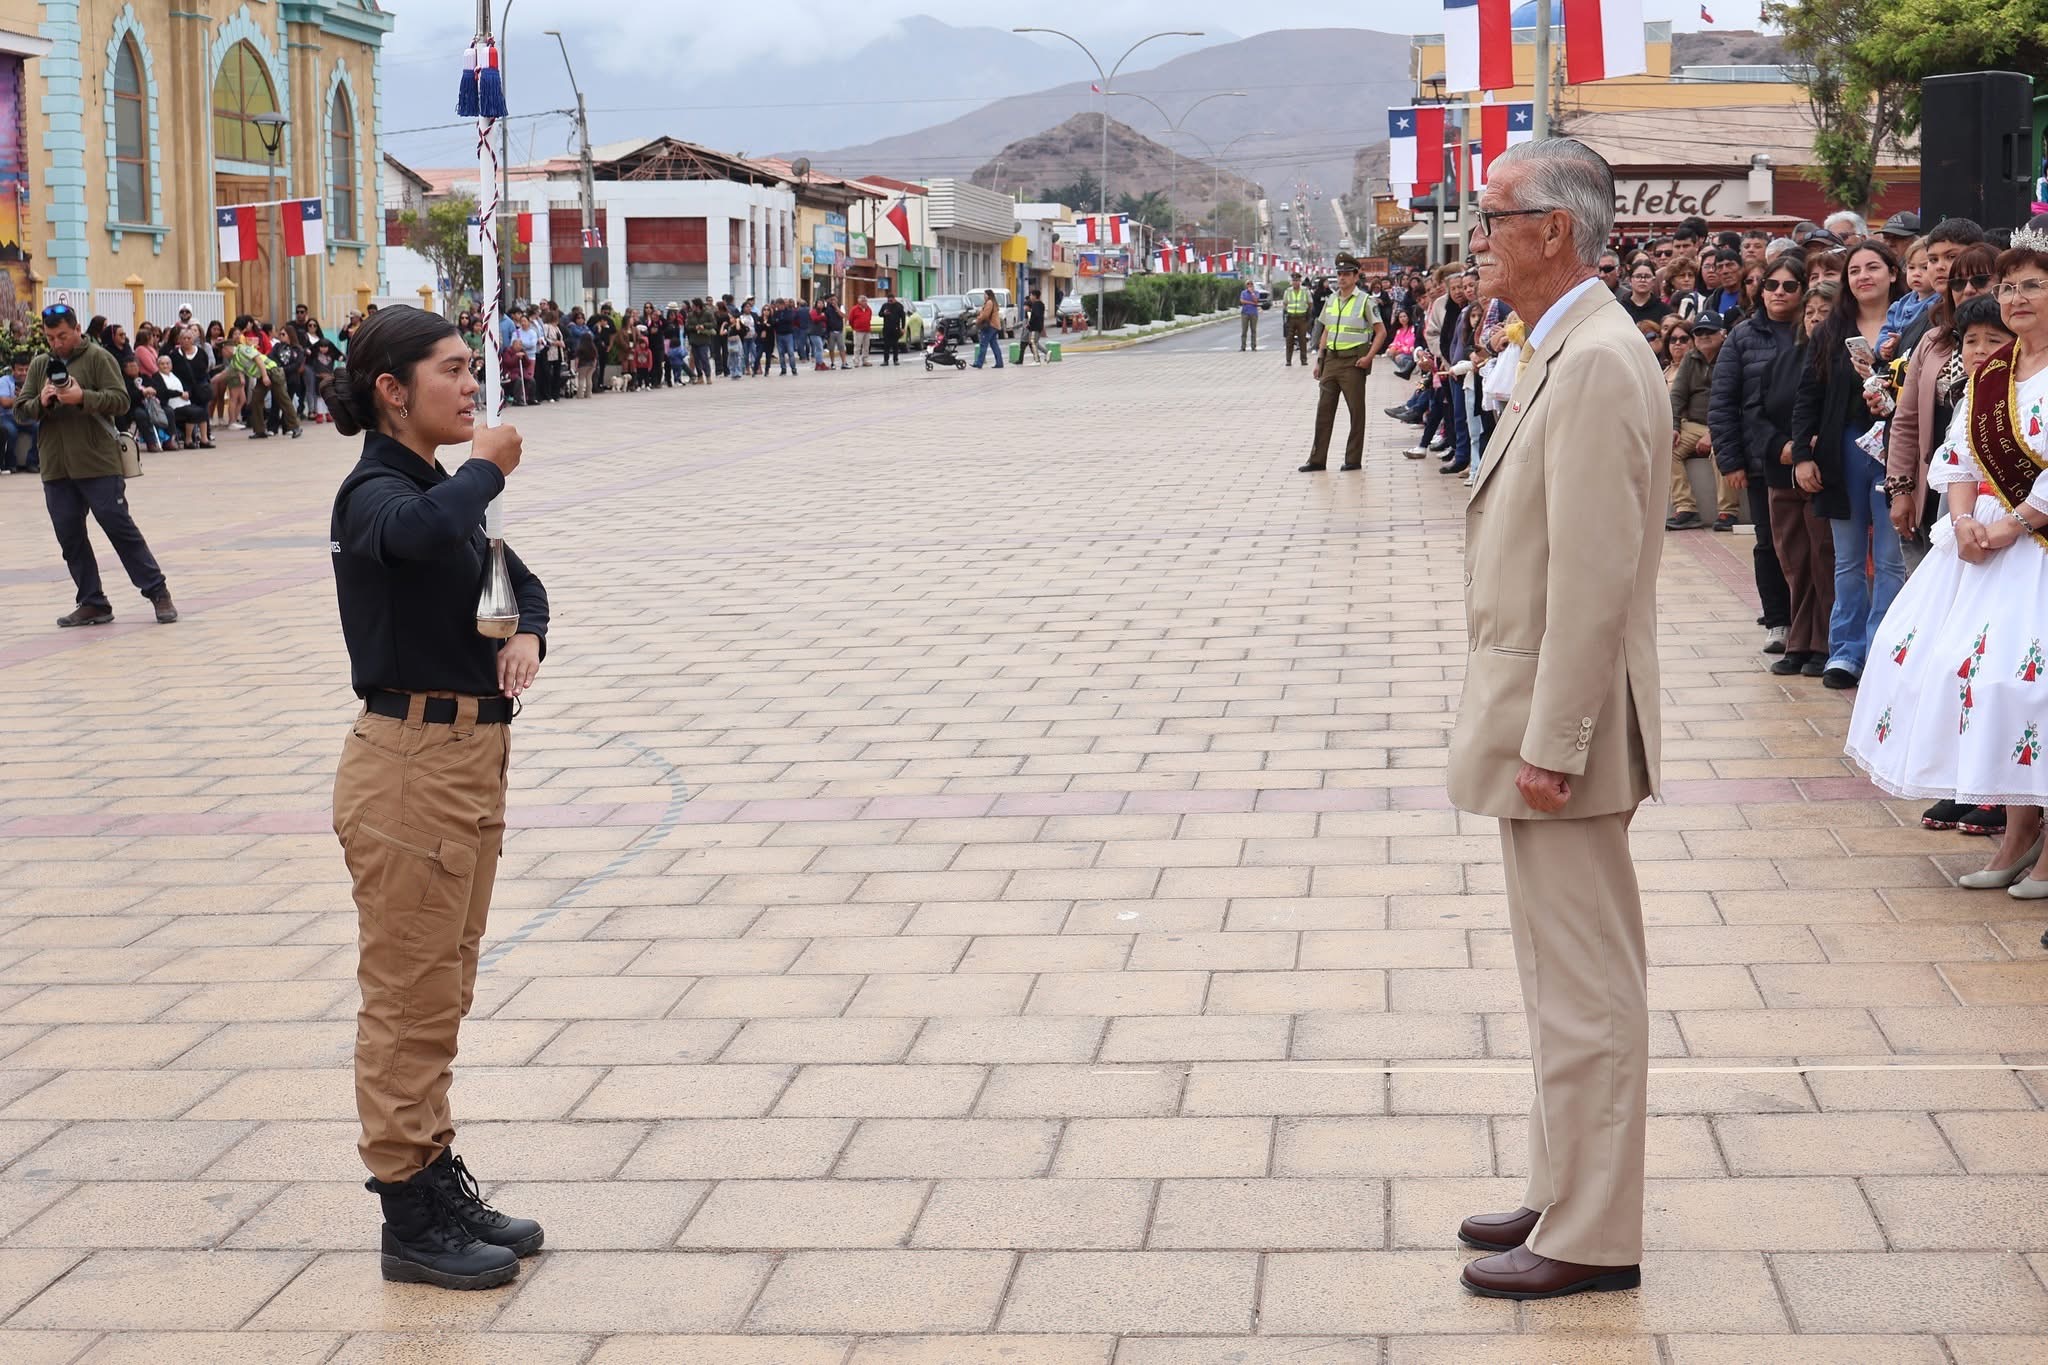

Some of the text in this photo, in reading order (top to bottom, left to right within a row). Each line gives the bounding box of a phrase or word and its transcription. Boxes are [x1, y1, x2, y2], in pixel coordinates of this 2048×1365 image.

[1977, 413, 2028, 501] Aniversario 16
[1993, 399, 2036, 481] Reina del Pa
